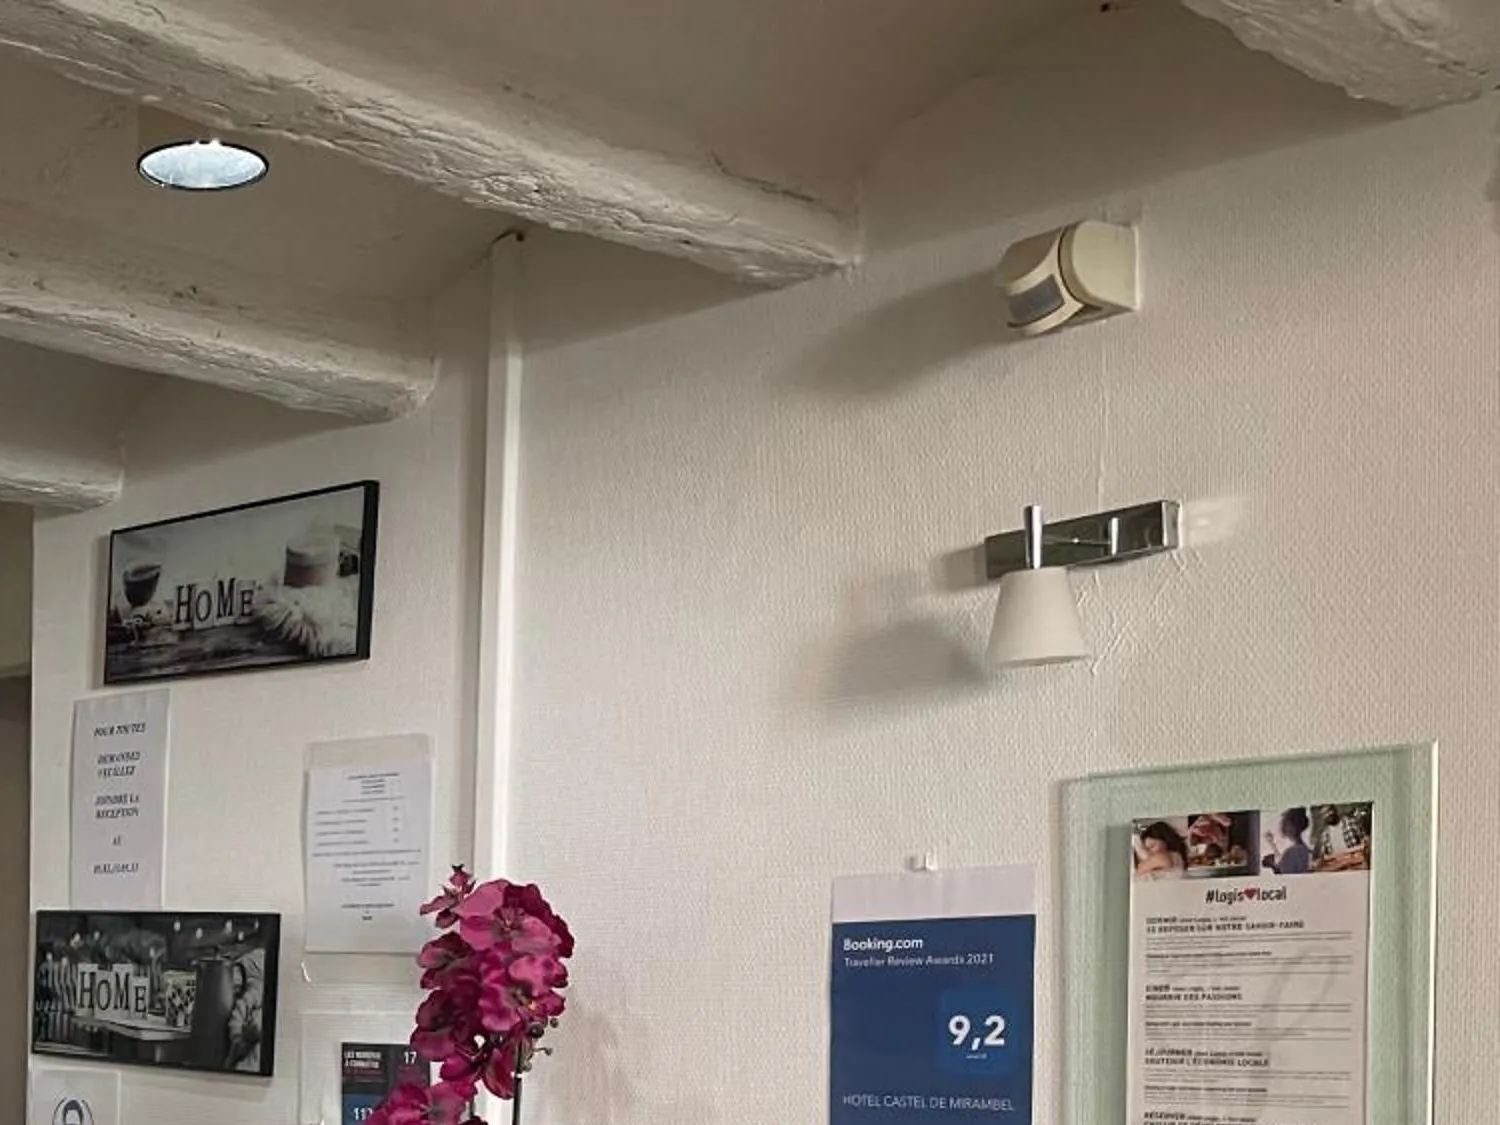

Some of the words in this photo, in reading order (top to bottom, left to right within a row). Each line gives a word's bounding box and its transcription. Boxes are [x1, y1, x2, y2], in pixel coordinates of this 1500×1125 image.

[843, 936, 924, 952] Booking.com
[887, 955, 923, 966] Review
[925, 954, 965, 966] Awards
[966, 953, 994, 965] 2021
[948, 1015, 1006, 1051] 9,2
[403, 1051, 417, 1064] 17
[843, 1094, 882, 1107] HOTEL
[883, 1095, 926, 1109] CASTEL
[929, 1097, 947, 1109] DE
[949, 1097, 1014, 1111] MIRAMBEL
